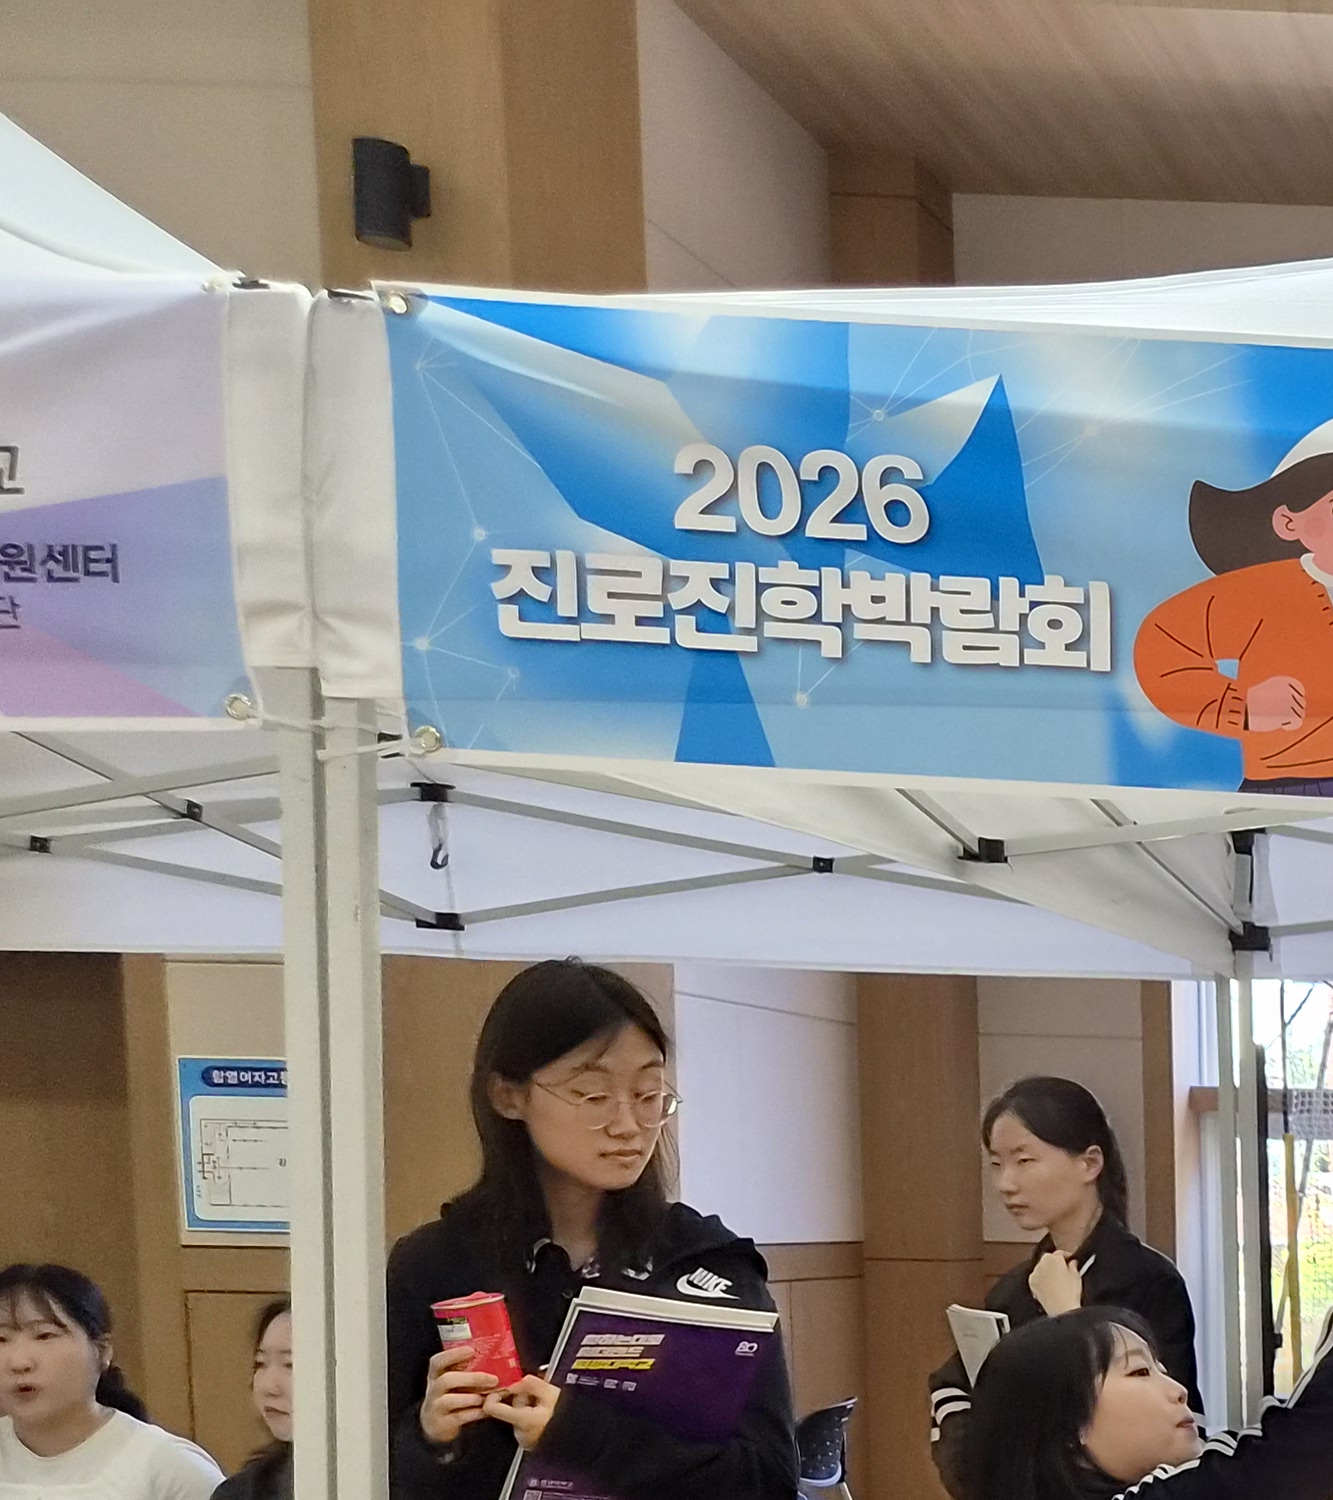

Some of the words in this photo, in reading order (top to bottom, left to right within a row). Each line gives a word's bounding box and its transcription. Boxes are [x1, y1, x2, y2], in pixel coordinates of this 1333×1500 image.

[673, 443, 930, 544] 2026
[490, 547, 1112, 672] 진로진학박람회
[688, 1266, 734, 1293] NIKE
